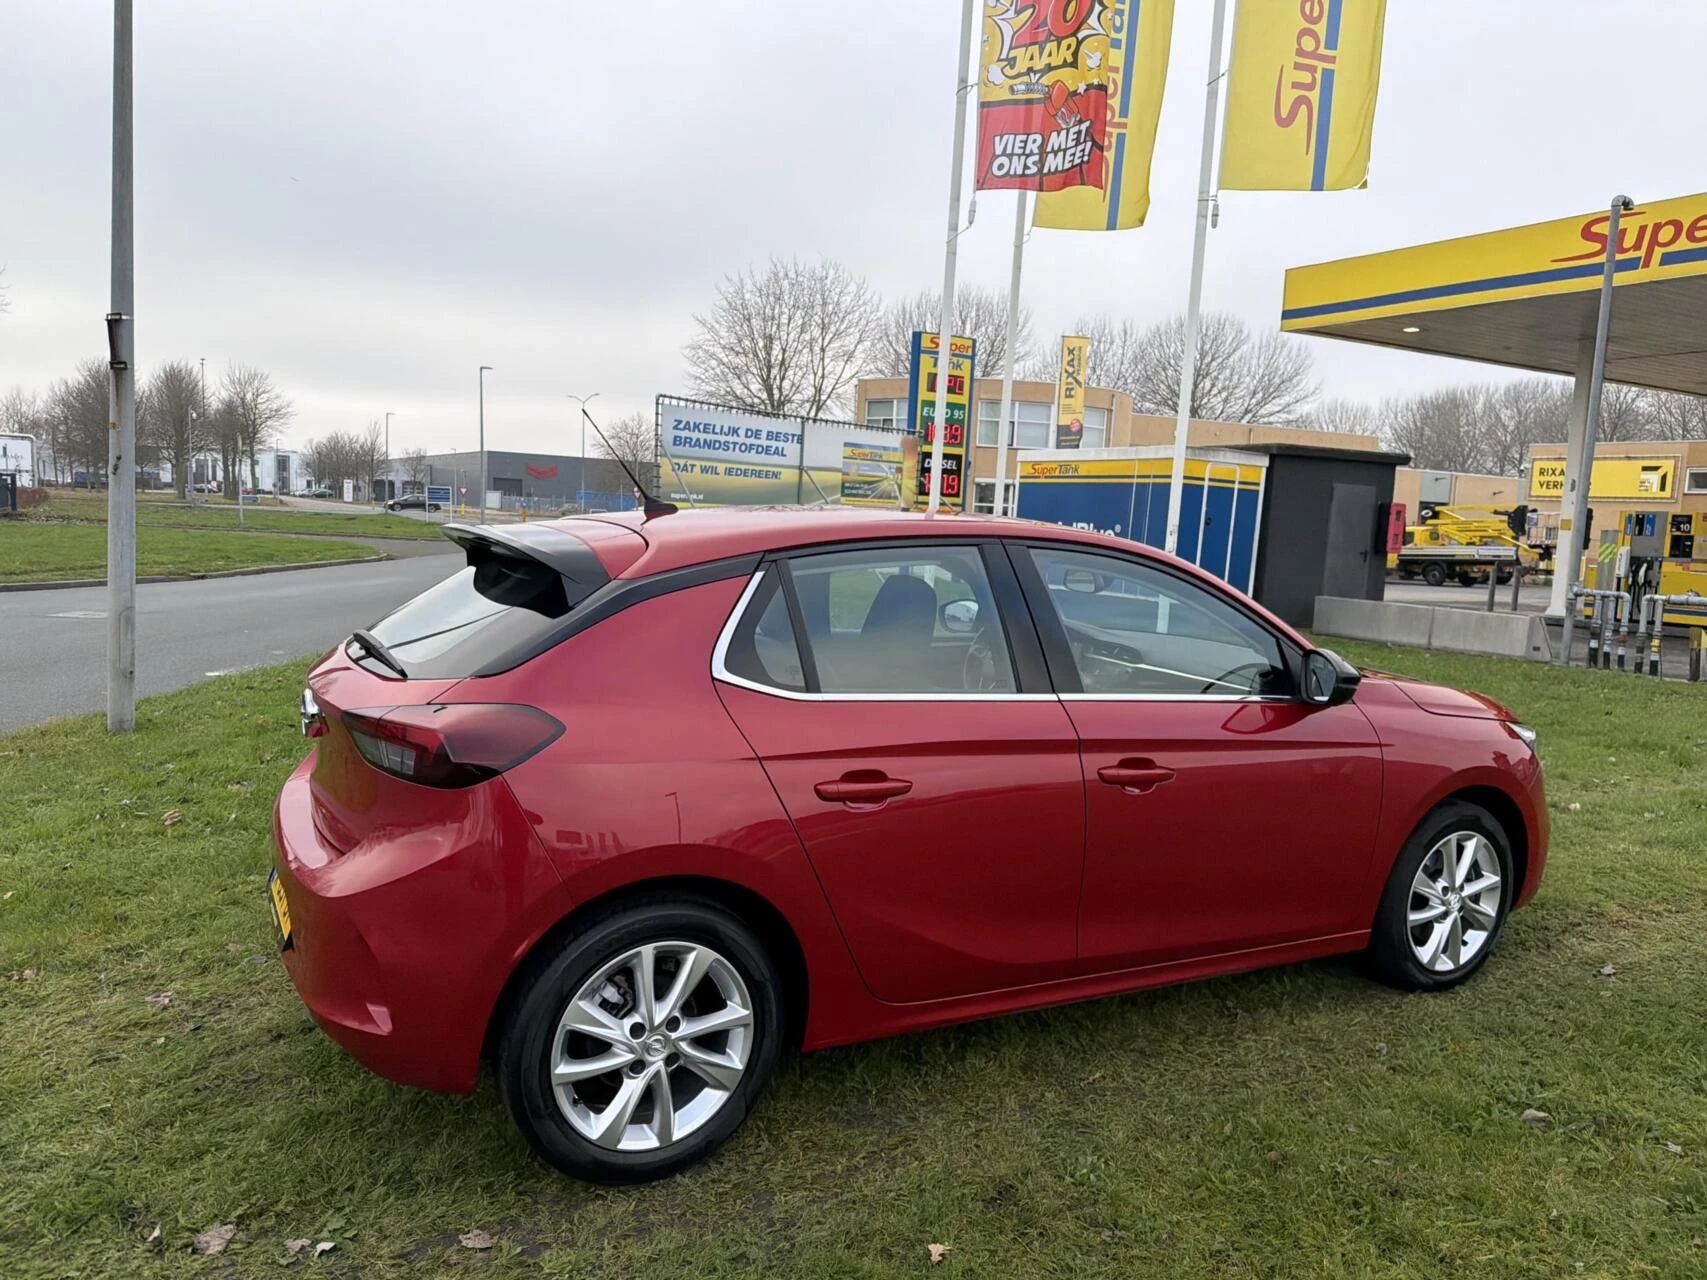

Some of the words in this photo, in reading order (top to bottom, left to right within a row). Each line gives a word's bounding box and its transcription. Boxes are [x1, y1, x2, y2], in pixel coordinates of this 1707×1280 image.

[1012, 0, 1089, 47] 20
[1003, 36, 1077, 74] JAAR
[994, 133, 1043, 156] VIER
[1045, 119, 1092, 153] MET
[991, 154, 1040, 177] ONS
[1042, 141, 1093, 174] MEE!
[922, 336, 972, 354] Sper
[930, 355, 963, 371] Tnk
[1064, 346, 1081, 399] RIXAX
[923, 407, 951, 418] EUO
[952, 409, 965, 420] 95
[673, 419, 742, 438] ZAKELIJK
[744, 428, 763, 440] DE
[766, 430, 803, 444] BESTE
[672, 434, 787, 457] BRANDSTOFDEAL
[700, 464, 720, 476] WIL
[724, 466, 782, 480] IEDEREEN!
[1538, 467, 1566, 477] RIXA
